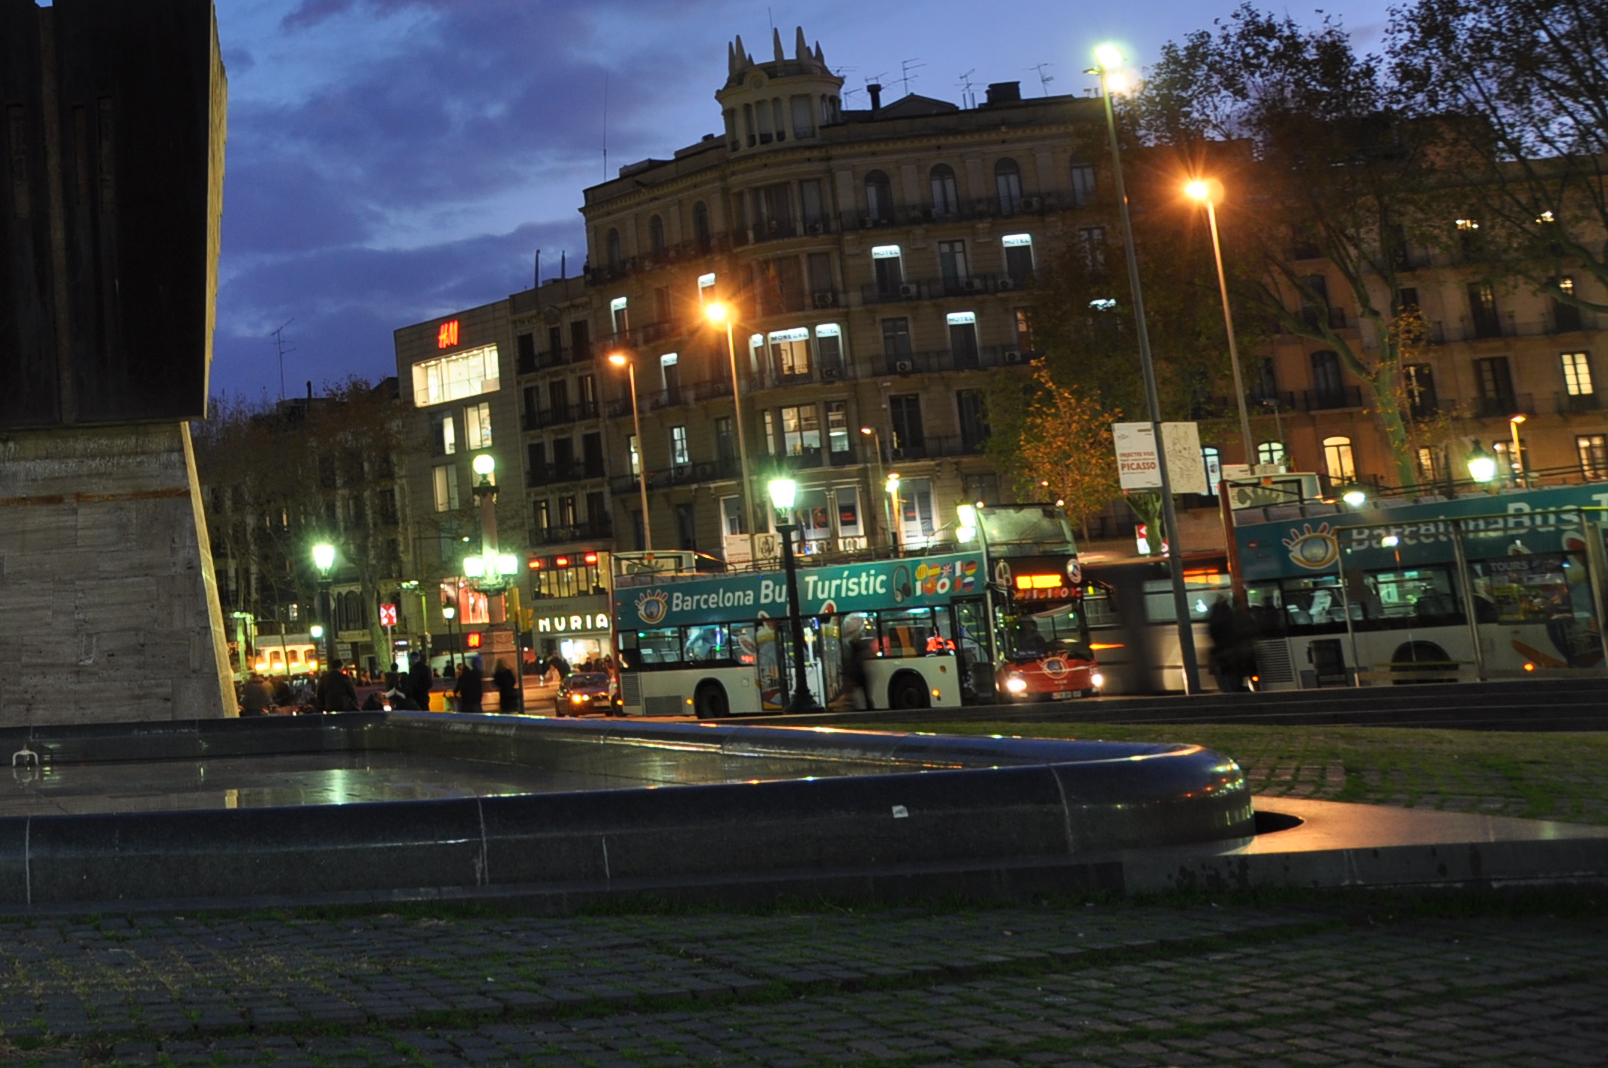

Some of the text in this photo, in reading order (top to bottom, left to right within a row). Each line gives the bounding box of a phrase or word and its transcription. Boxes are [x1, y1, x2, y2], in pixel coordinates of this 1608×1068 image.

[1121, 462, 1156, 472] PICASSO
[1490, 561, 1530, 572] TOURS
[672, 570, 887, 612] Barcelona Bu Turístic
[538, 613, 609, 632] NURIA
